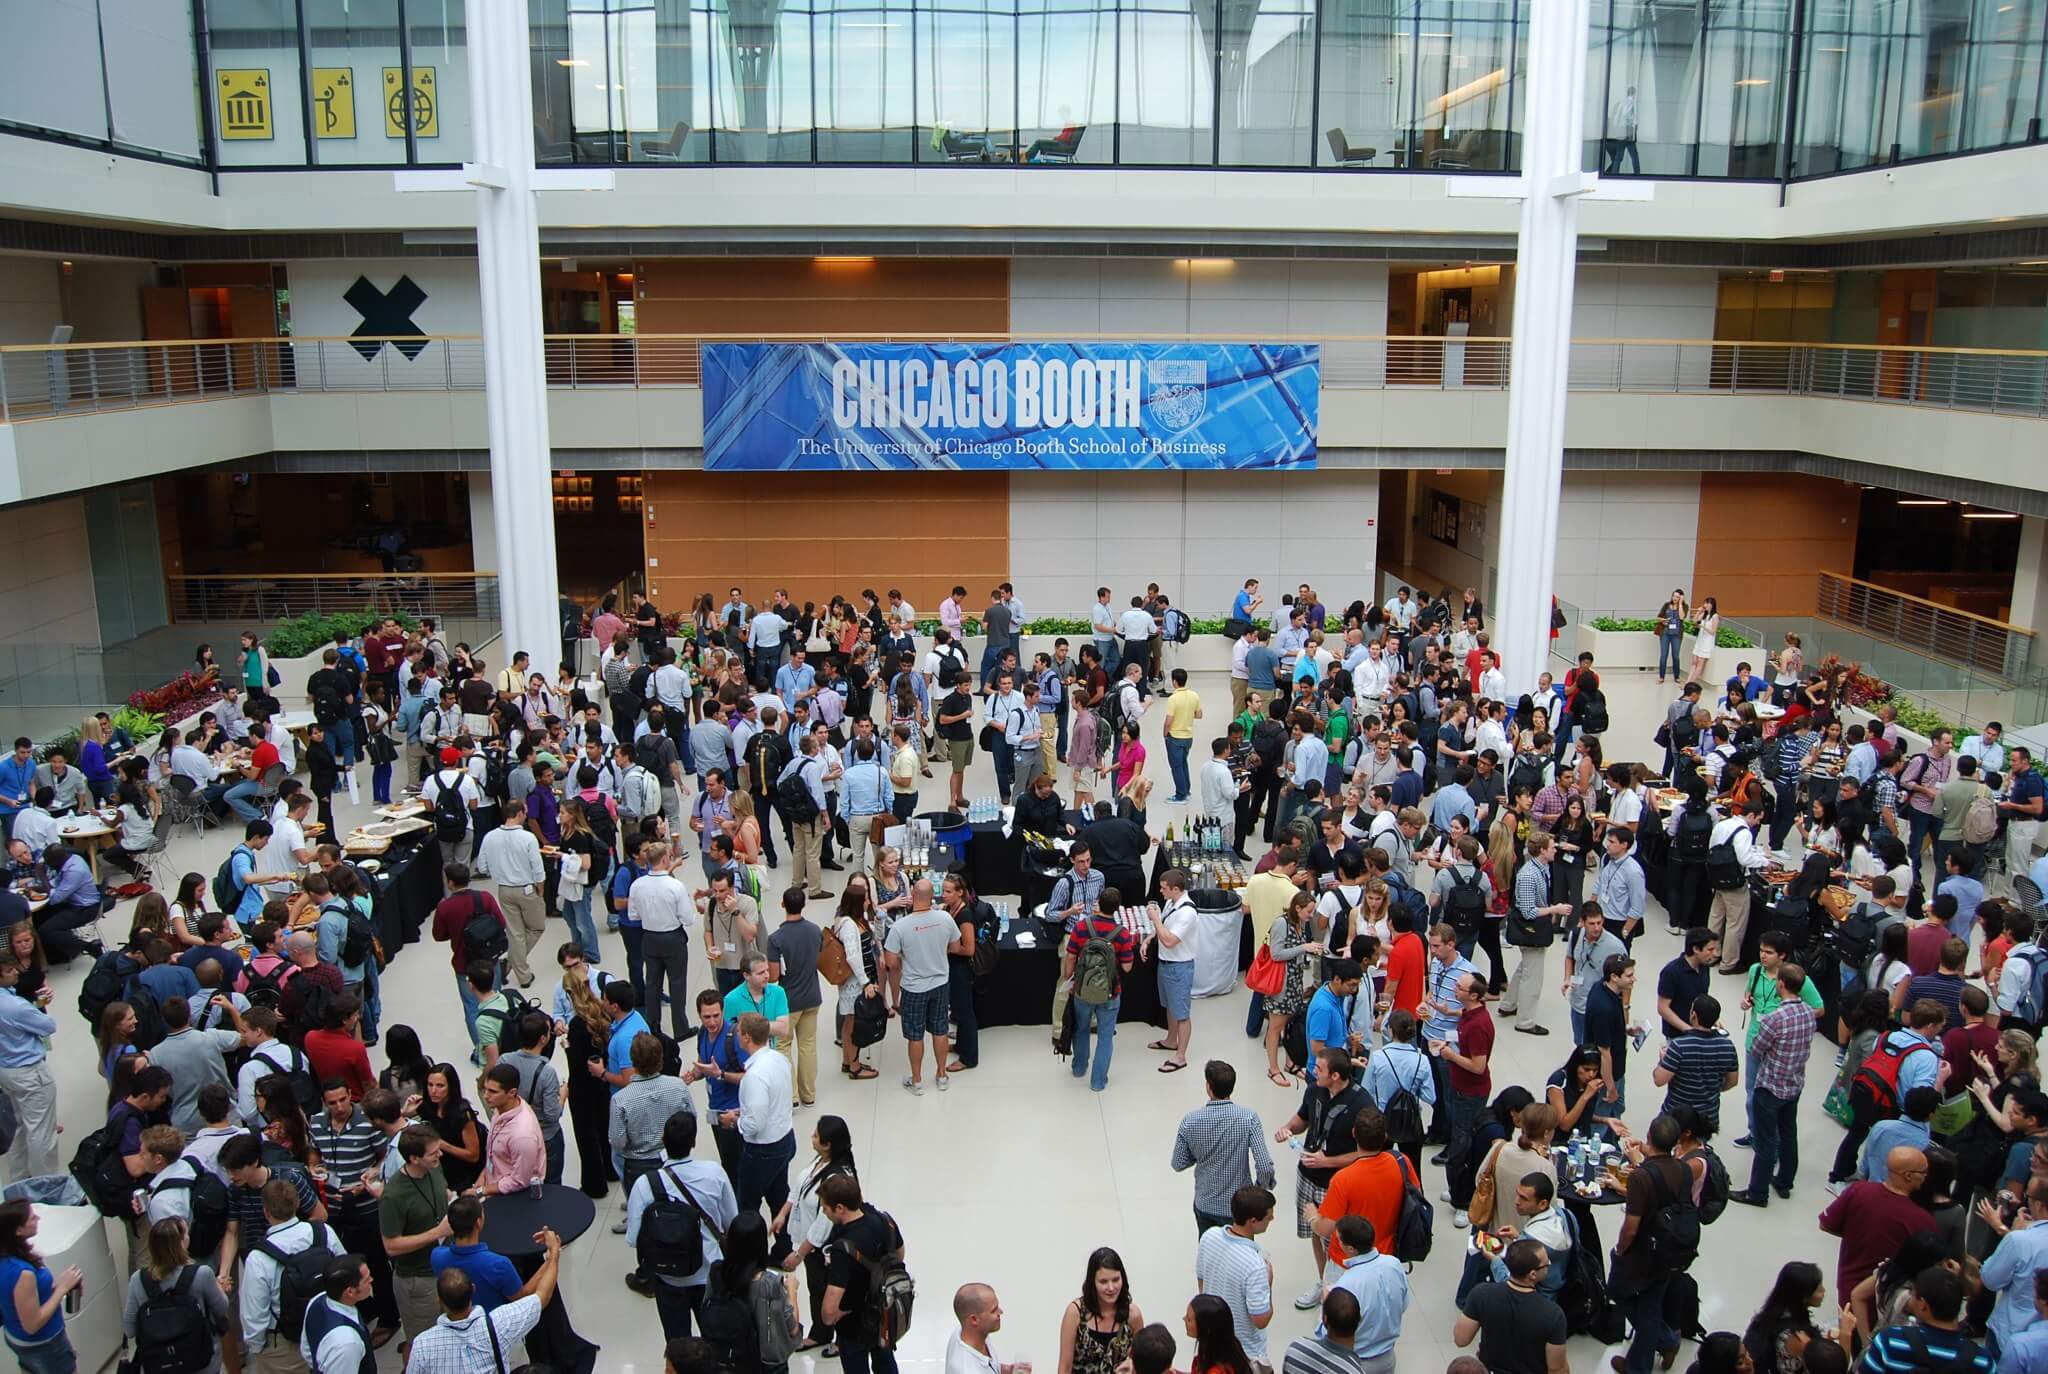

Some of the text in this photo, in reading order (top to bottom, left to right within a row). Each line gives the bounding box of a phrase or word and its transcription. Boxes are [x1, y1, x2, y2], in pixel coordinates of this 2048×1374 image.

[832, 358, 1141, 429] CHICAGO BOOTH
[798, 437, 1227, 460] The University of Chicago Booth School of Business
